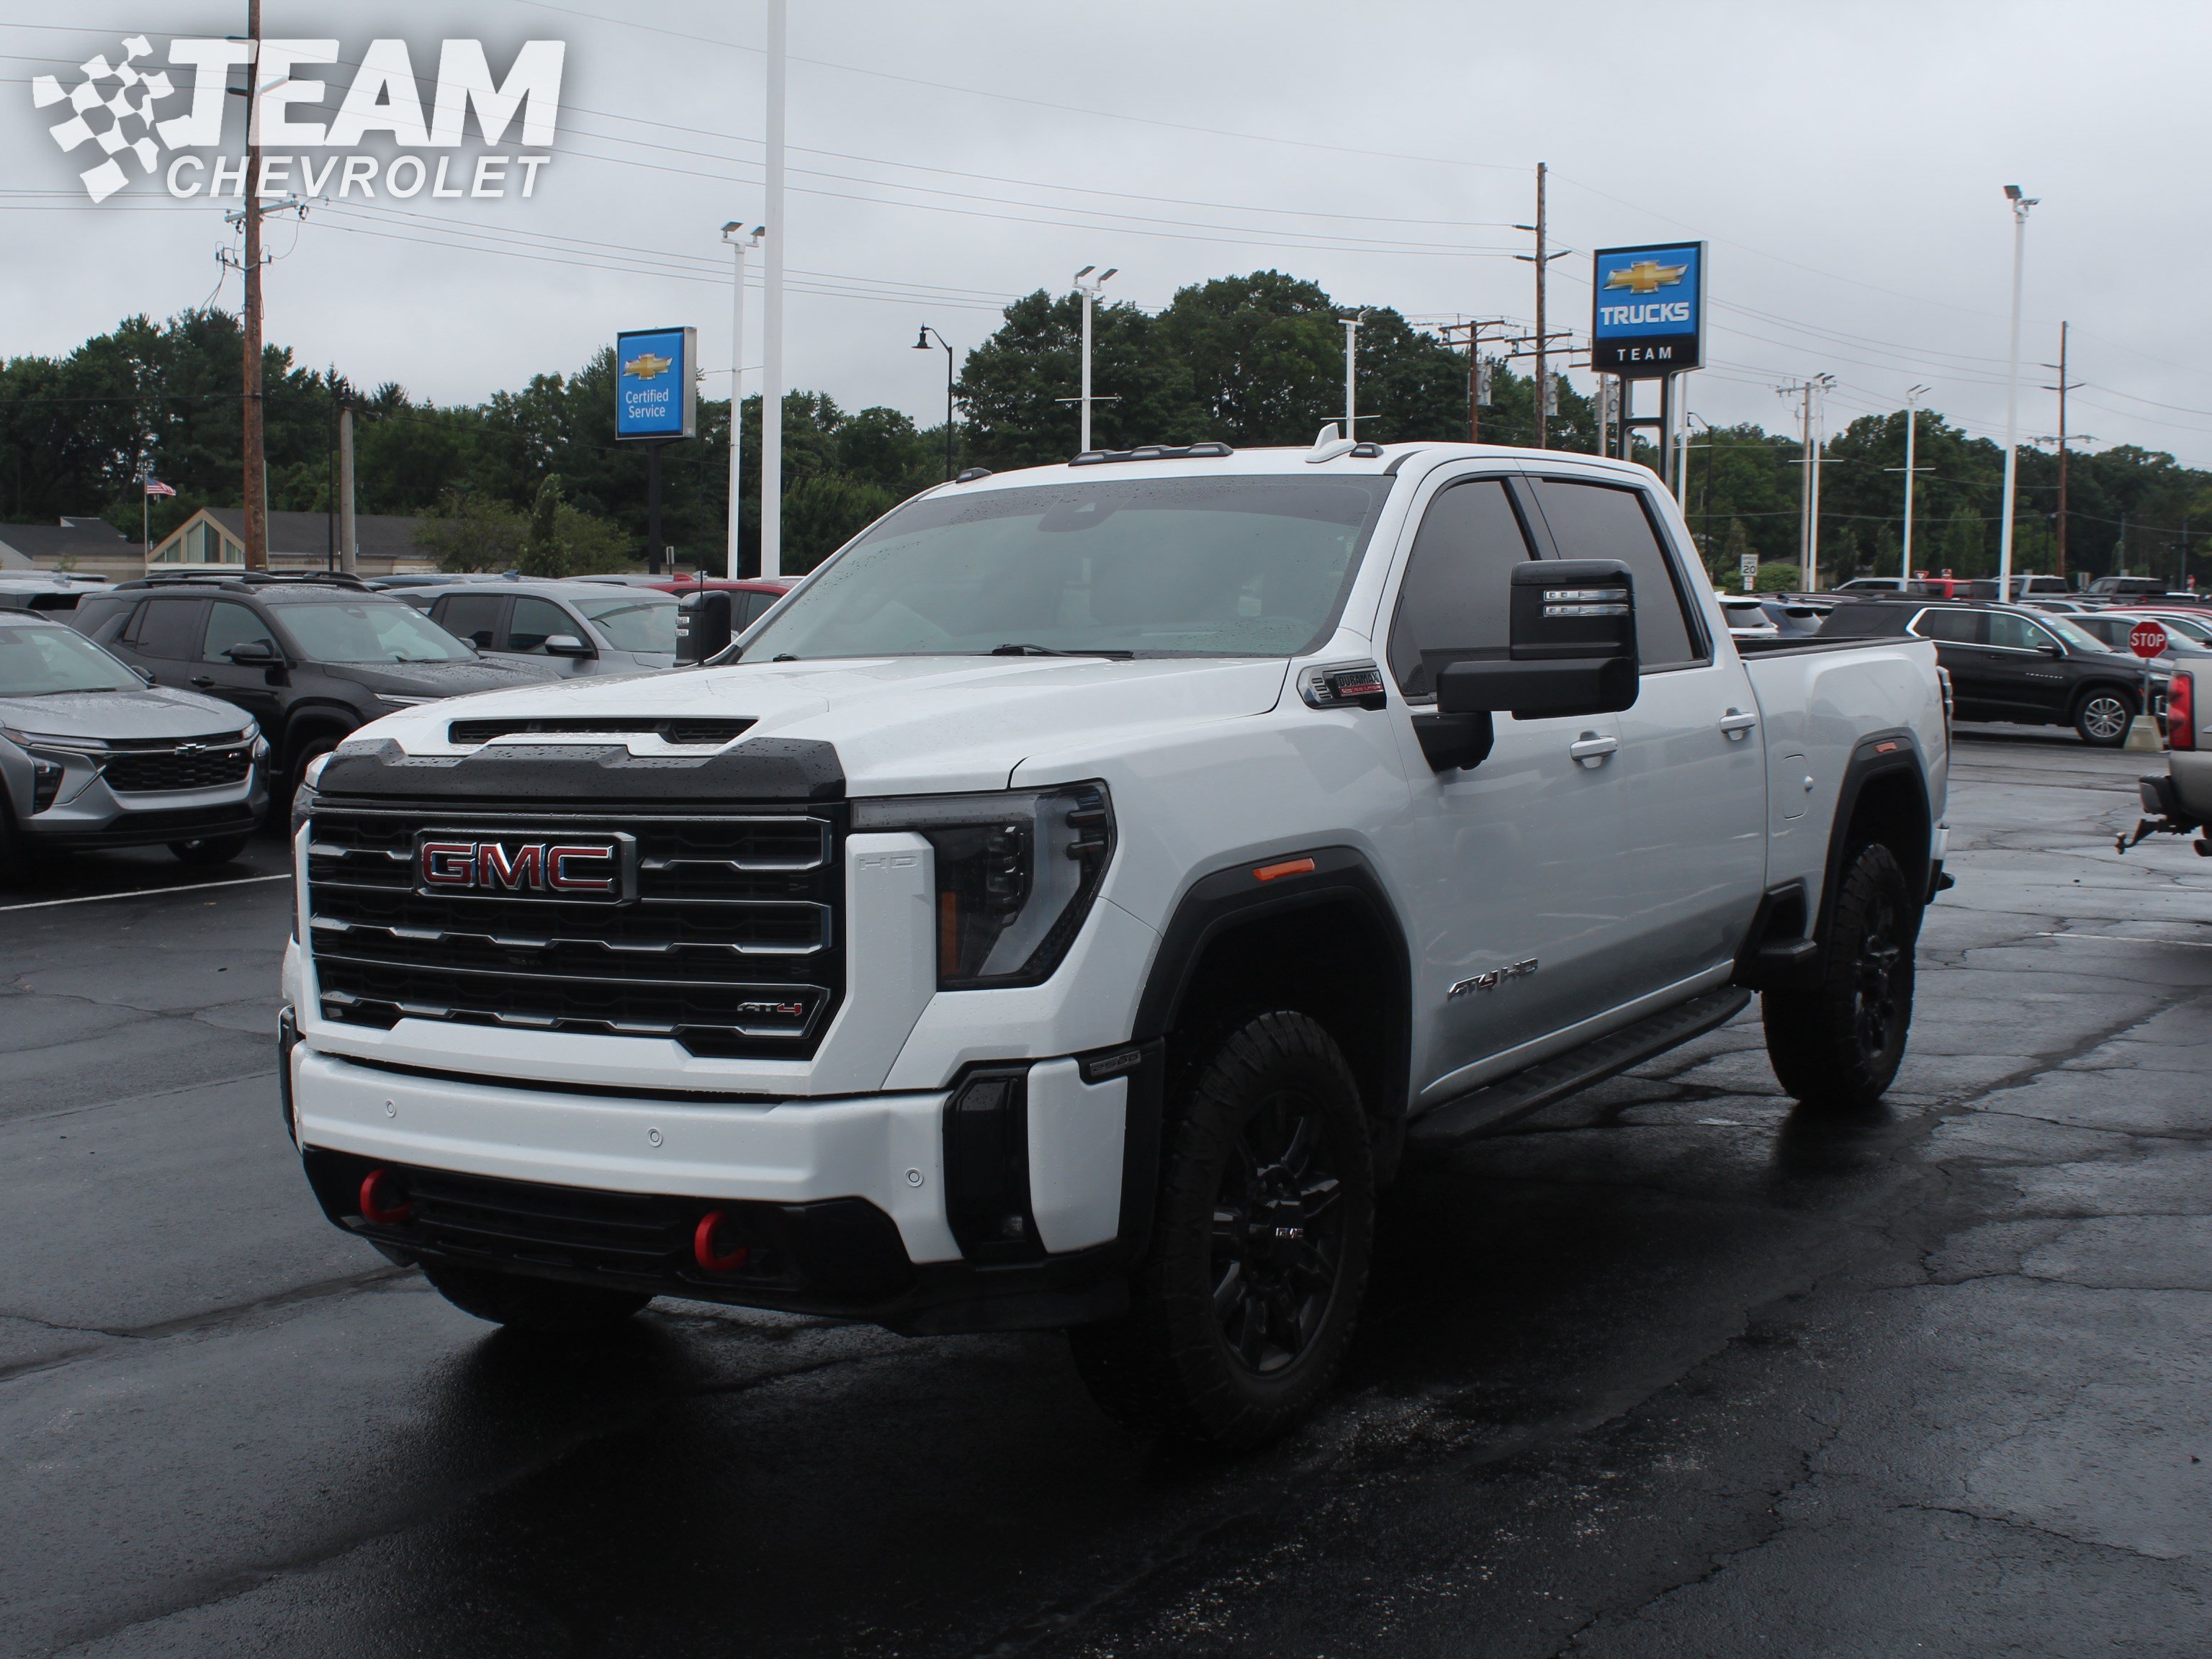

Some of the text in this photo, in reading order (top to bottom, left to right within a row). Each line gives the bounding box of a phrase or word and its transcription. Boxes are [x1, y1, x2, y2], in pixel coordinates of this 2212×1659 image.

[1600, 302, 1689, 326] TRUCKS
[1617, 346, 1673, 361] TEAM
[625, 388, 669, 404] Certified
[628, 405, 666, 418] Service
[1743, 565, 1756, 574] 20
[2131, 633, 2165, 647] STOP
[1339, 672, 1380, 687] DURAMAX
[421, 842, 614, 891] GMC
[859, 855, 918, 871] HD
[1447, 969, 1498, 1002] AT4
[737, 1002, 802, 1017] AT4
